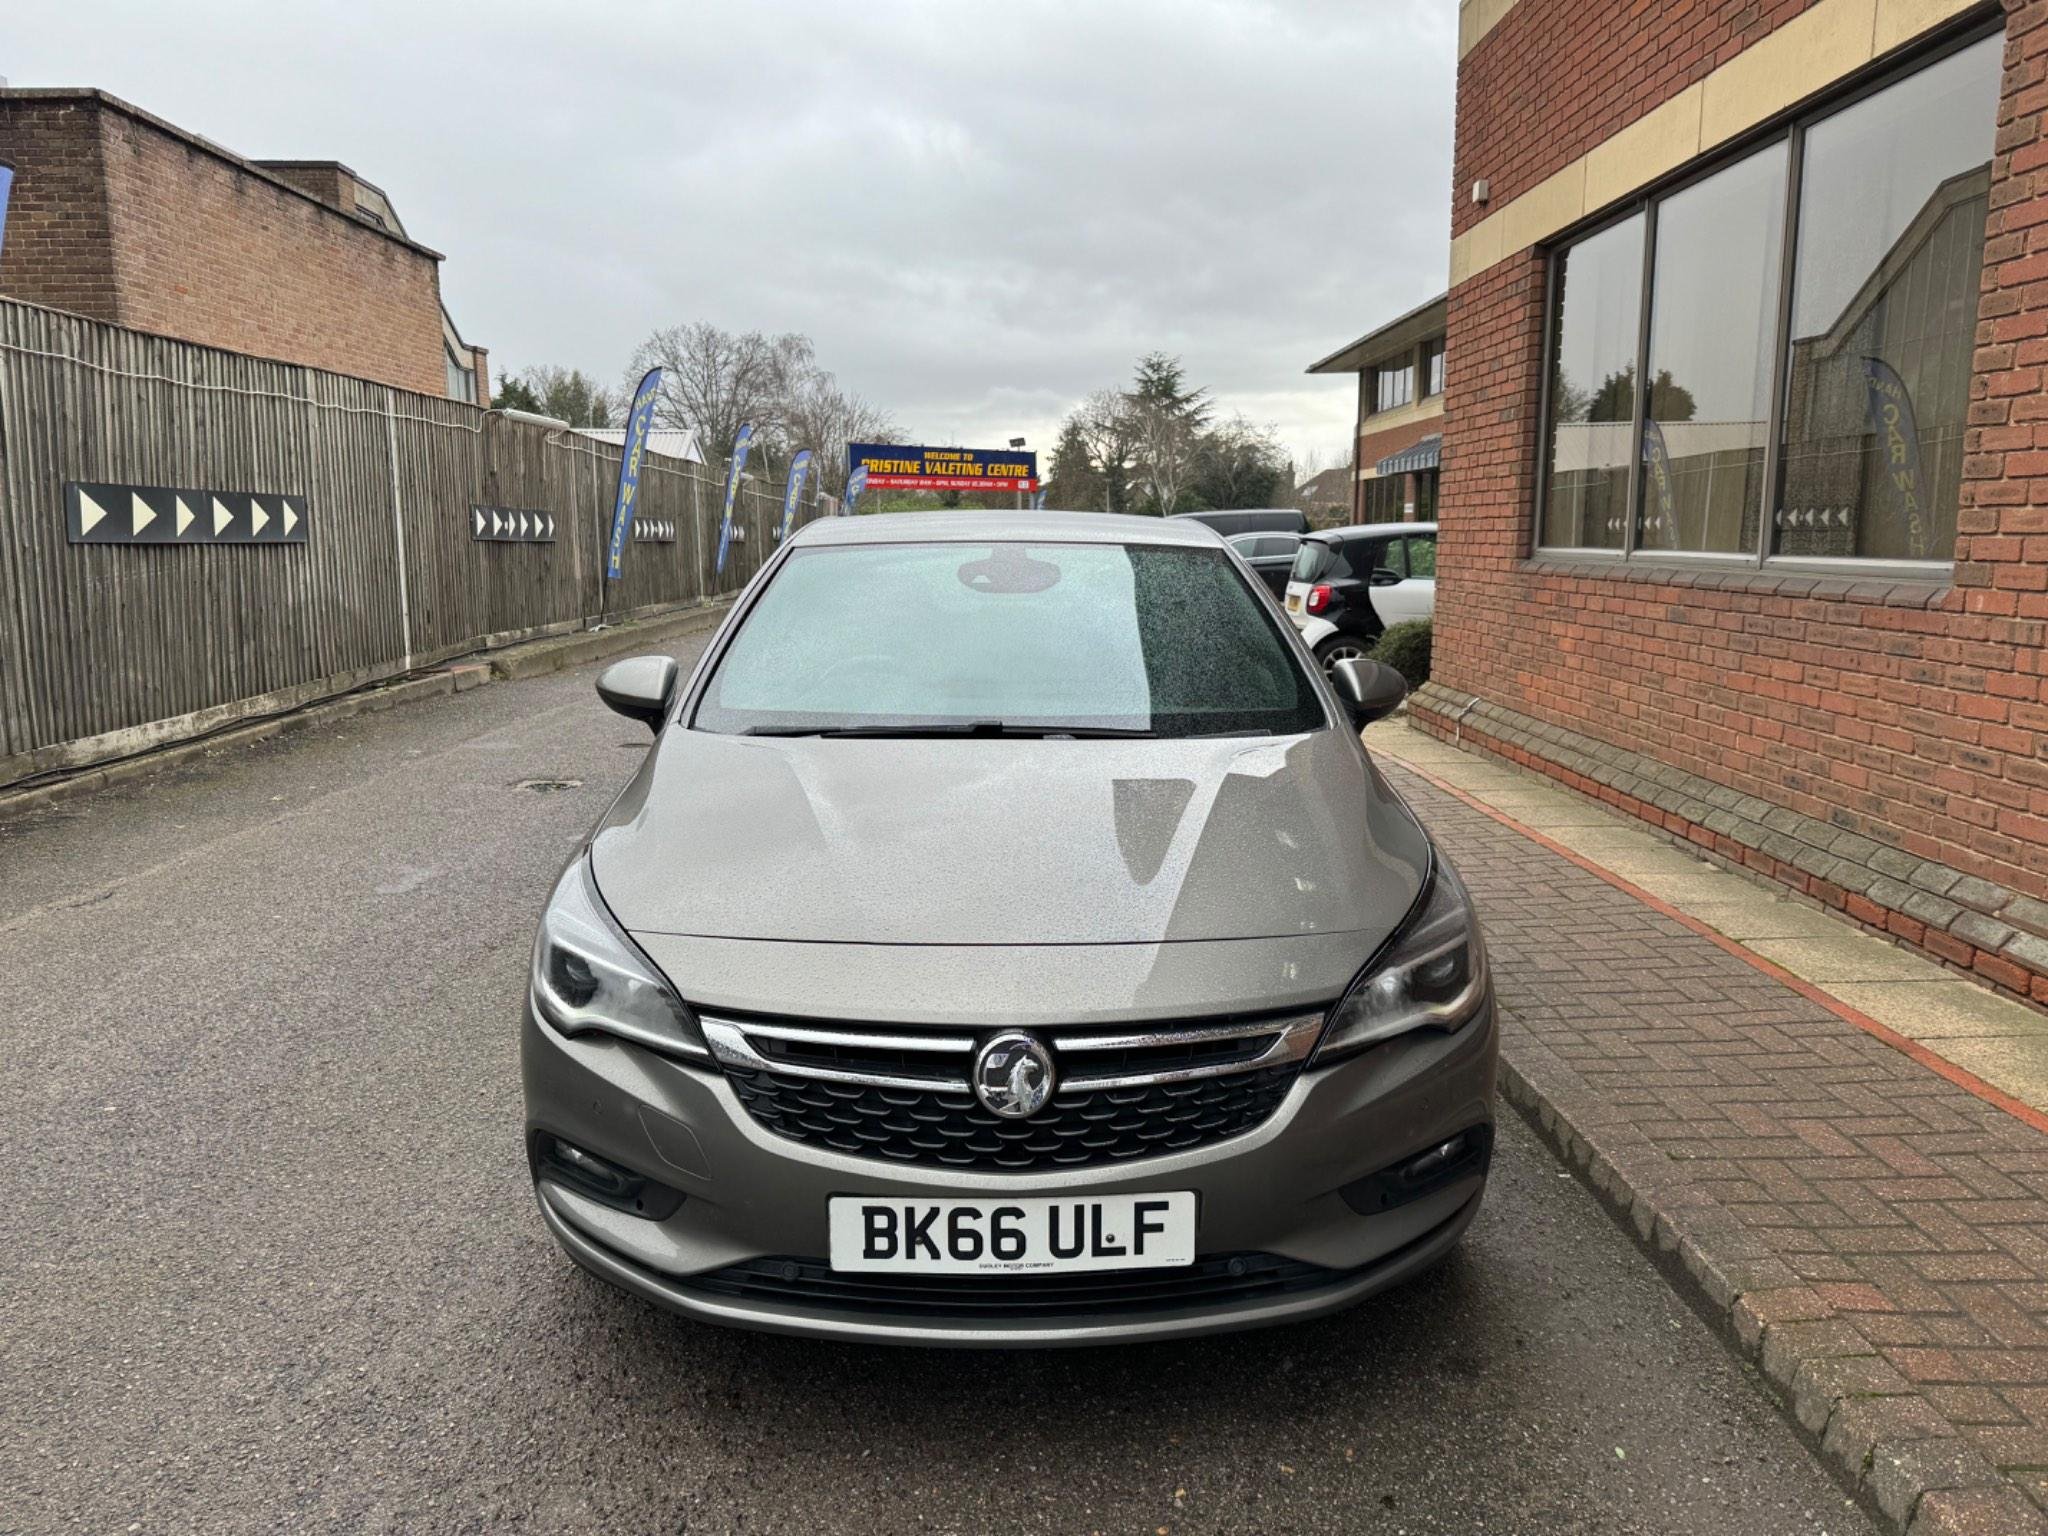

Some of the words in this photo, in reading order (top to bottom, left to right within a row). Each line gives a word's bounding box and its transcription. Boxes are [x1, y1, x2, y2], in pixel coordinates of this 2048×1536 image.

[628, 415, 647, 478] CAR
[924, 451, 961, 461] WELCOME
[963, 453, 974, 461] TO
[925, 461, 983, 476] VALETING
[987, 463, 1030, 477] CENTRE
[611, 482, 636, 570] WASH
[862, 1206, 1027, 1261] BK66
[1049, 1201, 1170, 1259] ULF
